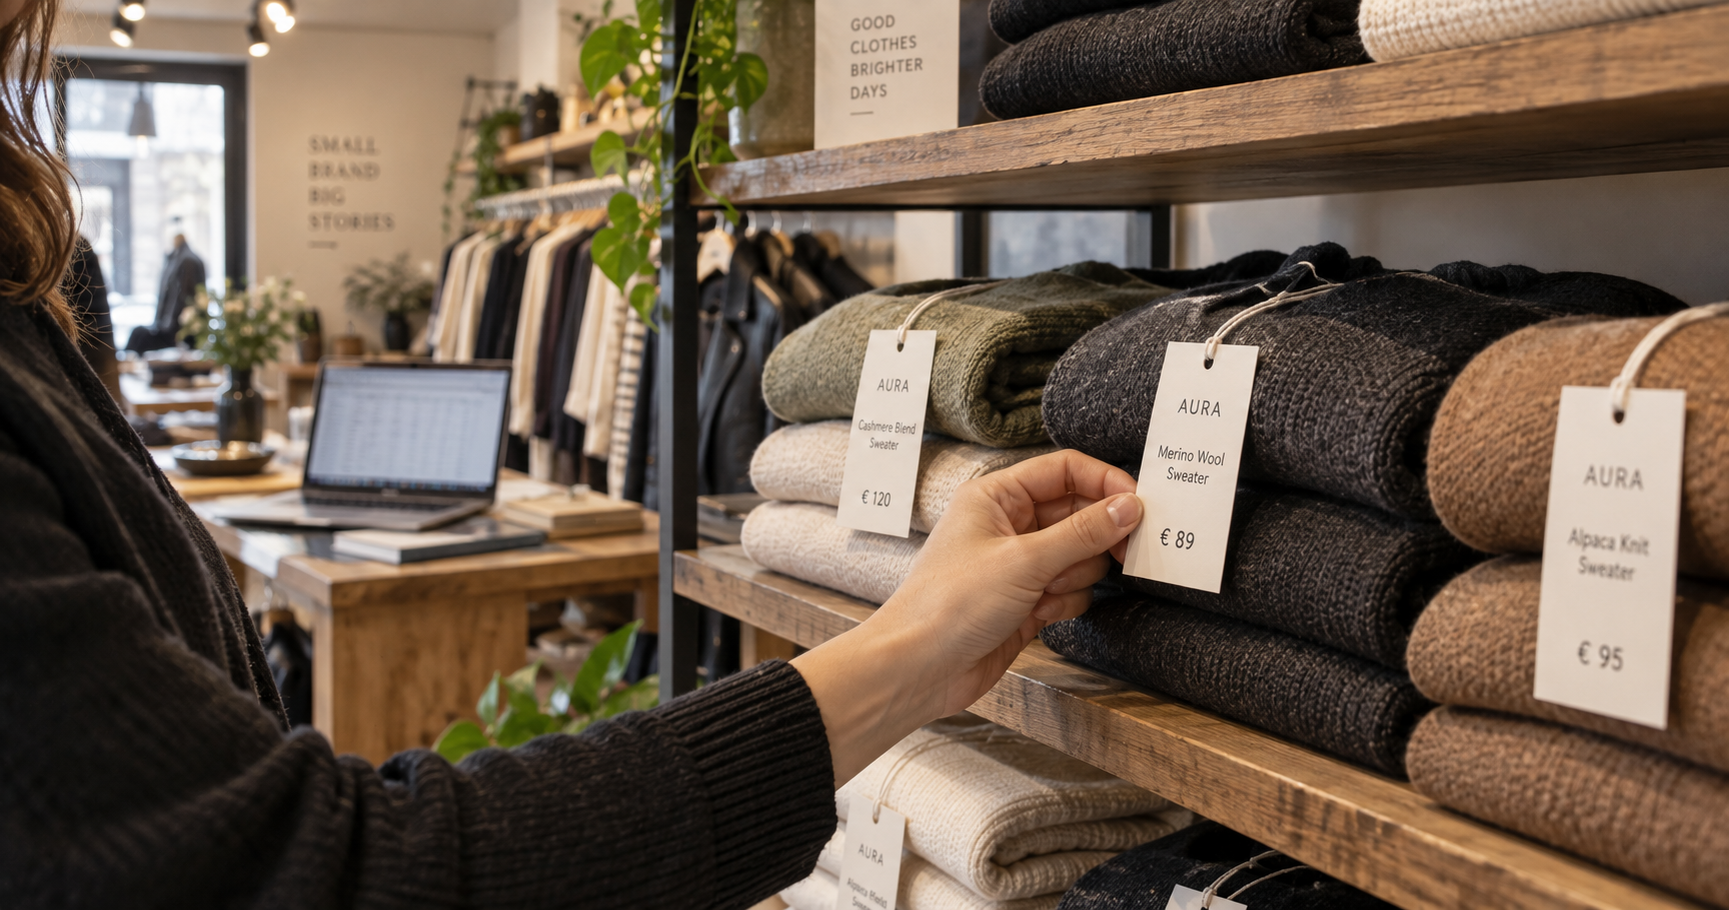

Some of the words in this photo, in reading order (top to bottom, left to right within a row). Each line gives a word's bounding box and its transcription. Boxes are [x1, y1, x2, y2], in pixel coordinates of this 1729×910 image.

[851, 14, 895, 32] GOOD
[850, 35, 917, 54] CLOTHES
[850, 57, 923, 77] BRIGHTER
[850, 83, 887, 100] DAYS
[309, 135, 380, 155] SMALL
[309, 160, 380, 181] BRAND
[309, 185, 345, 206] BIG
[309, 211, 395, 232] STORIES
[877, 378, 909, 393] AURA
[1177, 398, 1221, 418] AURA
[858, 418, 892, 433] Cashmere
[894, 421, 917, 435] Blend
[869, 436, 899, 451] Sweater
[1157, 444, 1194, 463] Merino
[1197, 449, 1226, 467] Wool
[1166, 466, 1209, 485] Sweater
[1583, 464, 1644, 491] AURA
[861, 489, 870, 505] €
[872, 490, 892, 508] 120
[1159, 528, 1171, 547] €
[1175, 530, 1195, 550] 89
[1567, 528, 1616, 552] Alpaca
[1620, 534, 1650, 557] Knit
[1577, 555, 1635, 582] Sweater
[1577, 640, 1591, 666] €
[1598, 644, 1624, 671] 95
[858, 843, 884, 866] AURA
